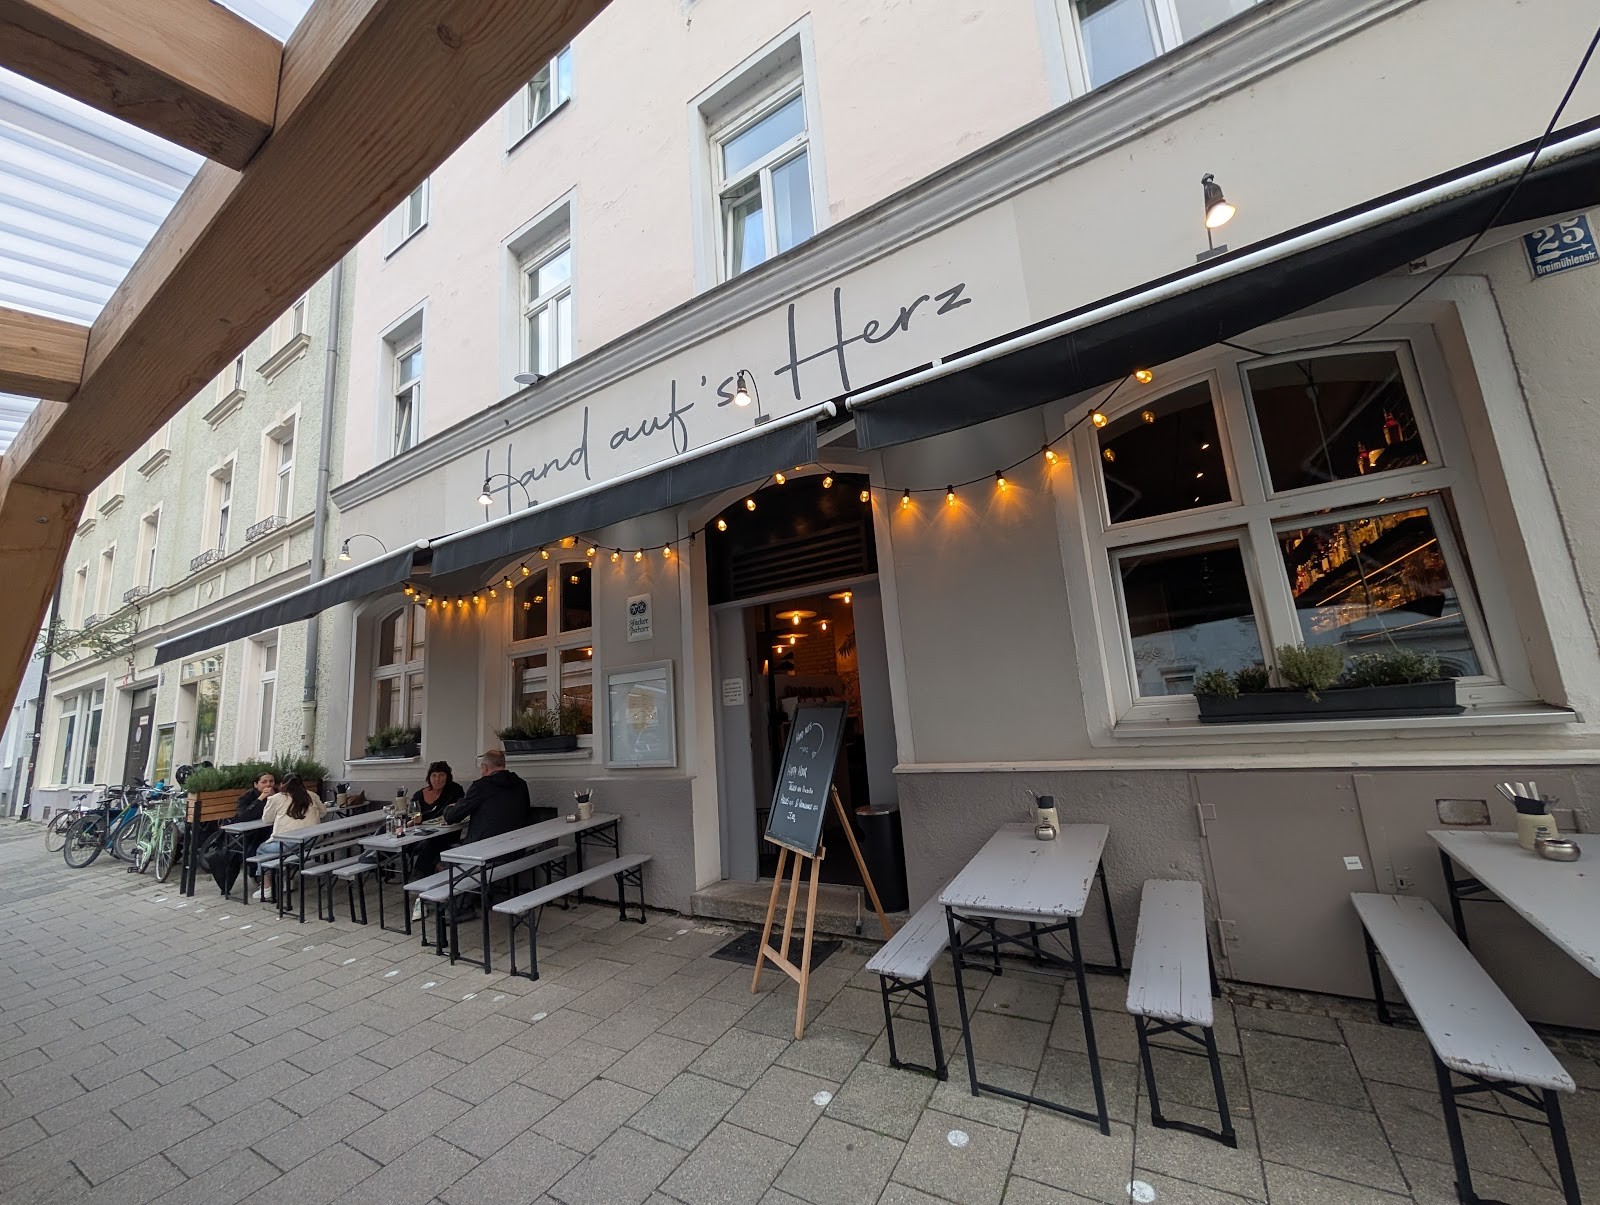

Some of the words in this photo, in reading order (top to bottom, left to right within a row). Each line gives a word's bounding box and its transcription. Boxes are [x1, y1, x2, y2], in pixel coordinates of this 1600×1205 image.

[1532, 217, 1584, 253] 25
[485, 406, 592, 521] Hand
[609, 375, 735, 455] auf's
[773, 283, 972, 401] Herz
